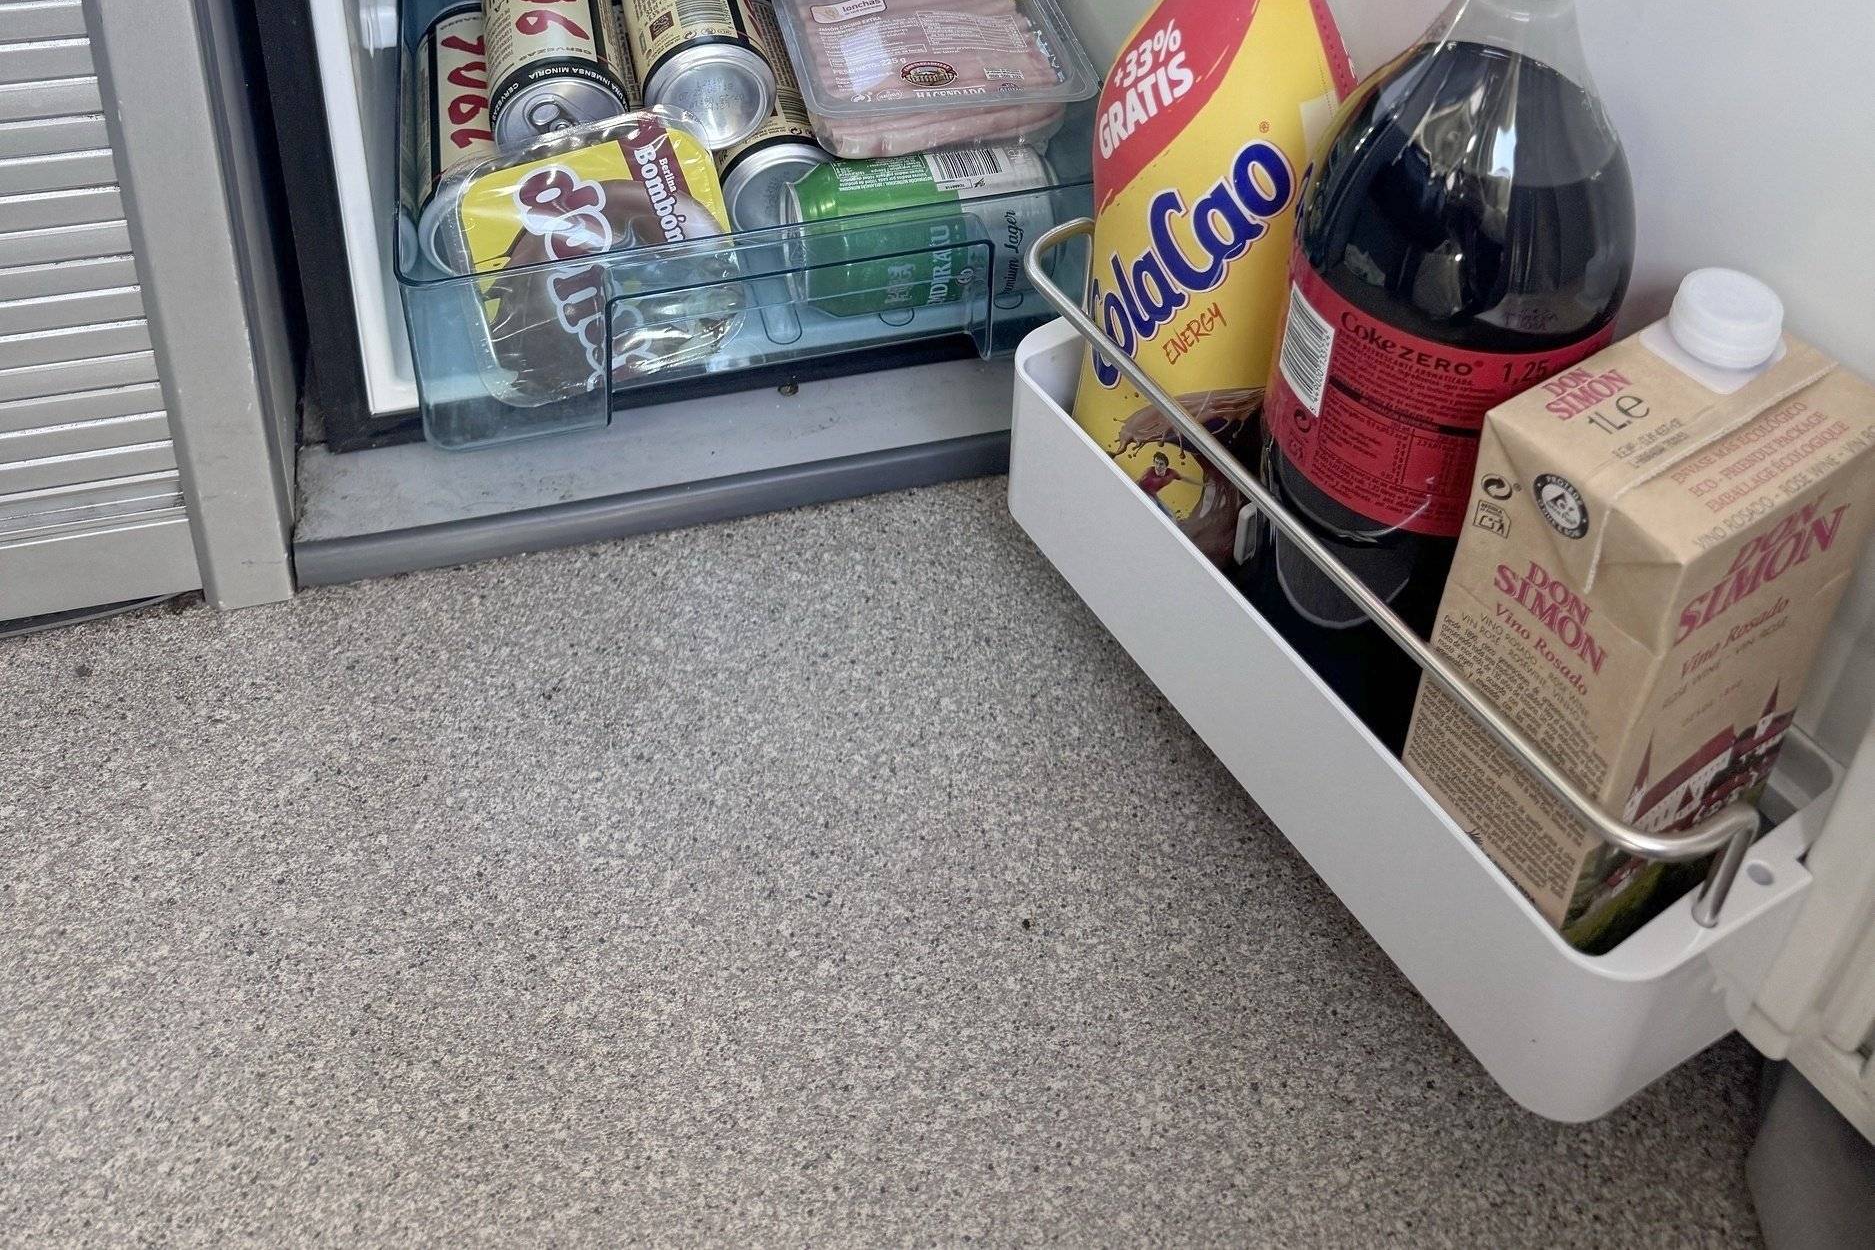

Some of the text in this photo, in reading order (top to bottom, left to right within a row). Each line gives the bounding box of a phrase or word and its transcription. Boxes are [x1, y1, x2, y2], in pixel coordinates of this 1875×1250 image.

[528, 66, 570, 80] MINORÍA
[571, 66, 610, 86] INMENSA
[1114, 18, 1182, 88] +33%
[1098, 51, 1194, 159] GRATIS
[634, 142, 686, 243] Bombón
[658, 157, 678, 193] Berlina
[1004, 209, 1024, 254] Lager
[1162, 303, 1228, 366] ENERGY
[1340, 310, 1550, 387] Coke ZERO 1,25
[1541, 366, 1595, 399] DON
[1545, 368, 1632, 421] SIMON
[1689, 476, 1718, 500] ECO
[1719, 440, 1779, 482] FRIENDLY
[1773, 408, 1830, 449] PACKAGE
[1705, 465, 1778, 515] EMBALLAGE
[1725, 491, 1831, 578] DON
[1528, 560, 1593, 626] DON
[1674, 502, 1851, 647] SIMON
[1460, 611, 1480, 630] VIN
[1478, 612, 1504, 636] VINO
[1502, 633, 1539, 666] ROSADO
[1493, 562, 1608, 675] SIMON
[1495, 603, 1589, 697] Vino Rosado
[1681, 596, 1790, 679] Vino Rosado
